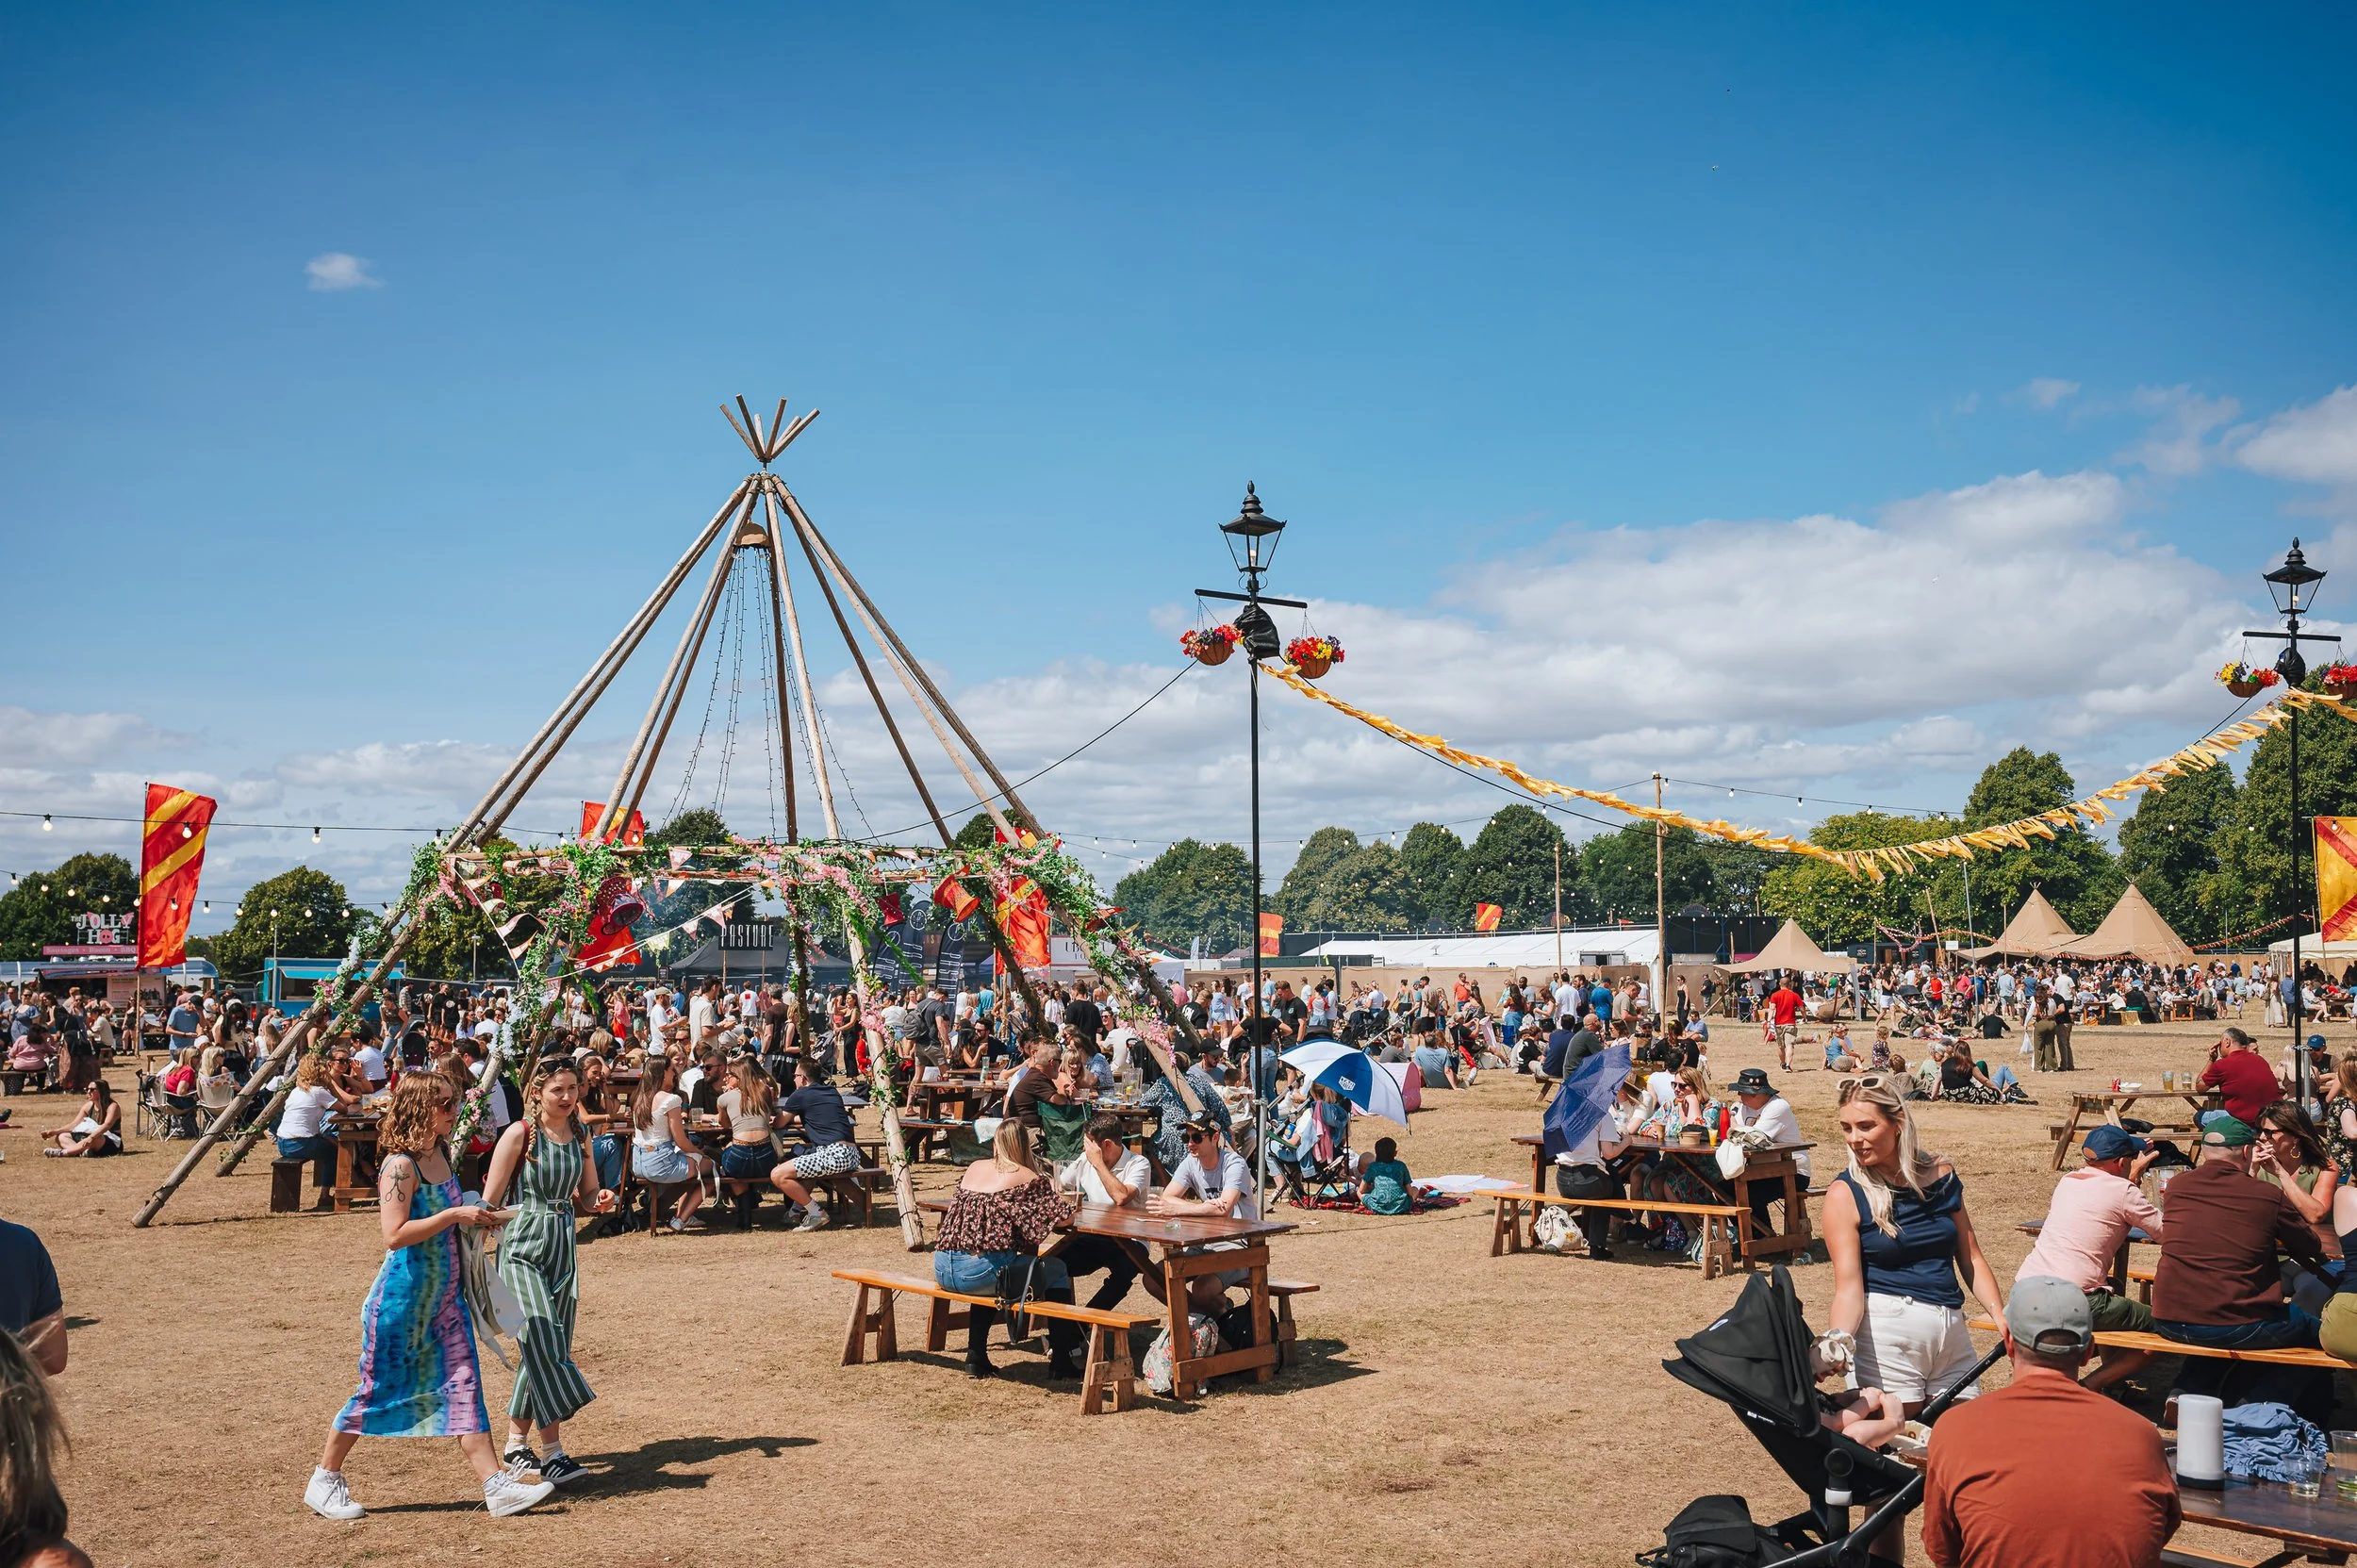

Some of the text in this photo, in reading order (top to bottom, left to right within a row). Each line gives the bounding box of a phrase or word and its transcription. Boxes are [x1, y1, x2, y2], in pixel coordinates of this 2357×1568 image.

[76, 913, 134, 929] JOLLY
[87, 929, 121, 944] HOG
[720, 924, 773, 947] PASTURE
